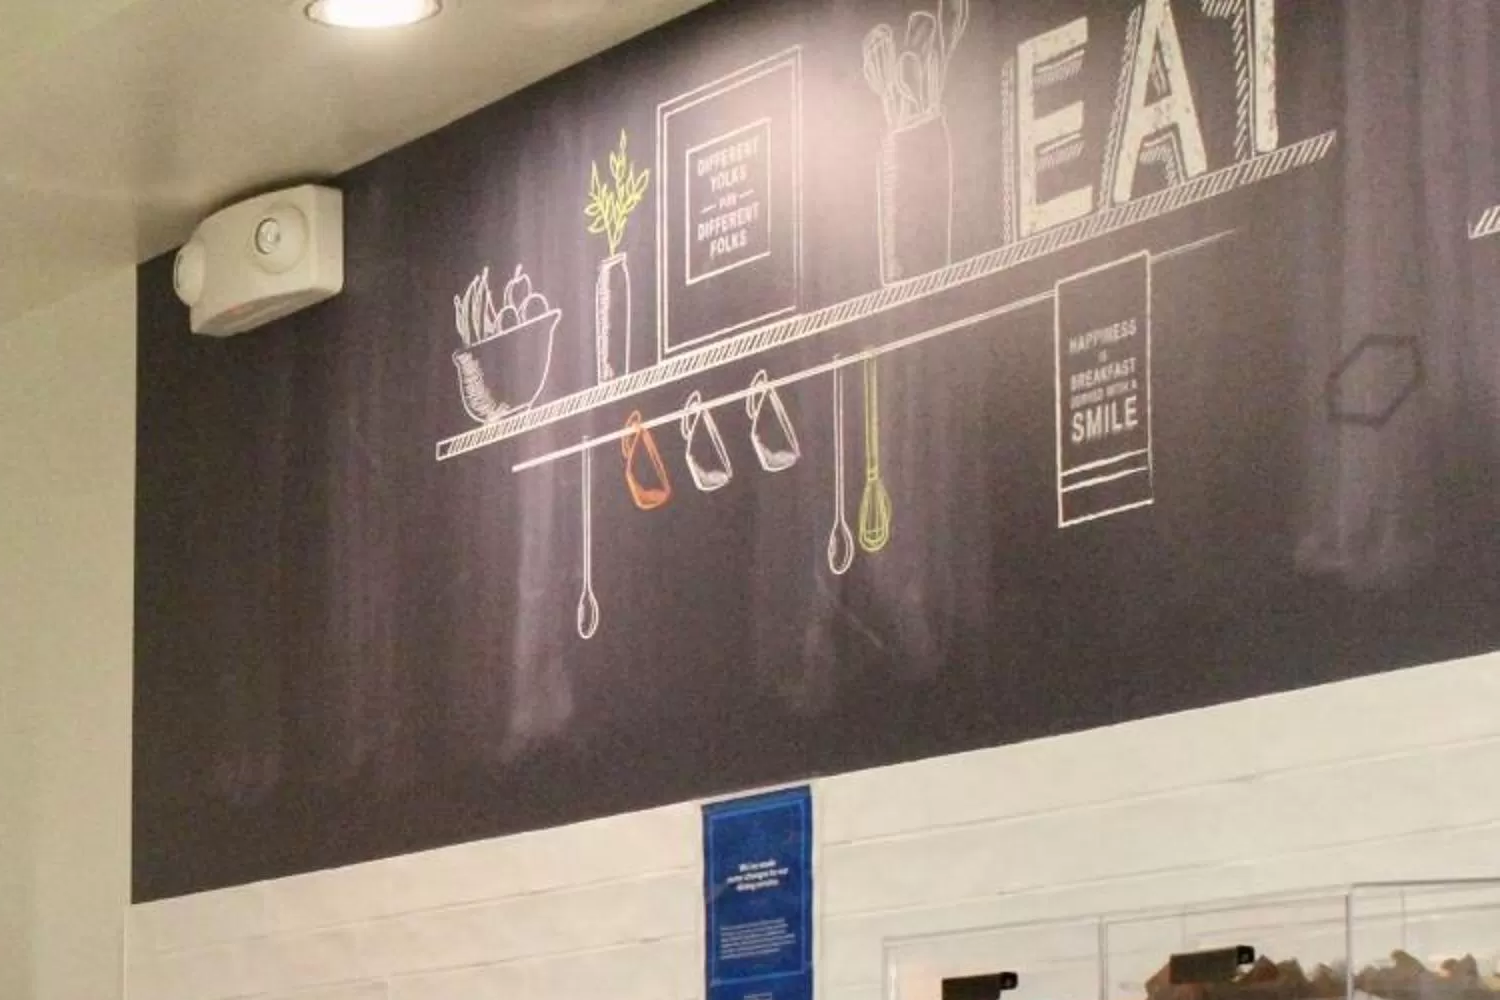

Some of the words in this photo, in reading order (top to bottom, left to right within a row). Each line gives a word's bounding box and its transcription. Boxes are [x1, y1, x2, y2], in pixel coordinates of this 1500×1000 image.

[710, 163, 748, 193] YOLKS
[697, 201, 760, 241] DIFFERENT
[709, 228, 748, 260] FOLKS
[1069, 318, 1137, 353] HAPPINESS
[1070, 357, 1137, 392] BREAKFAST
[1071, 394, 1139, 444] SMILE
